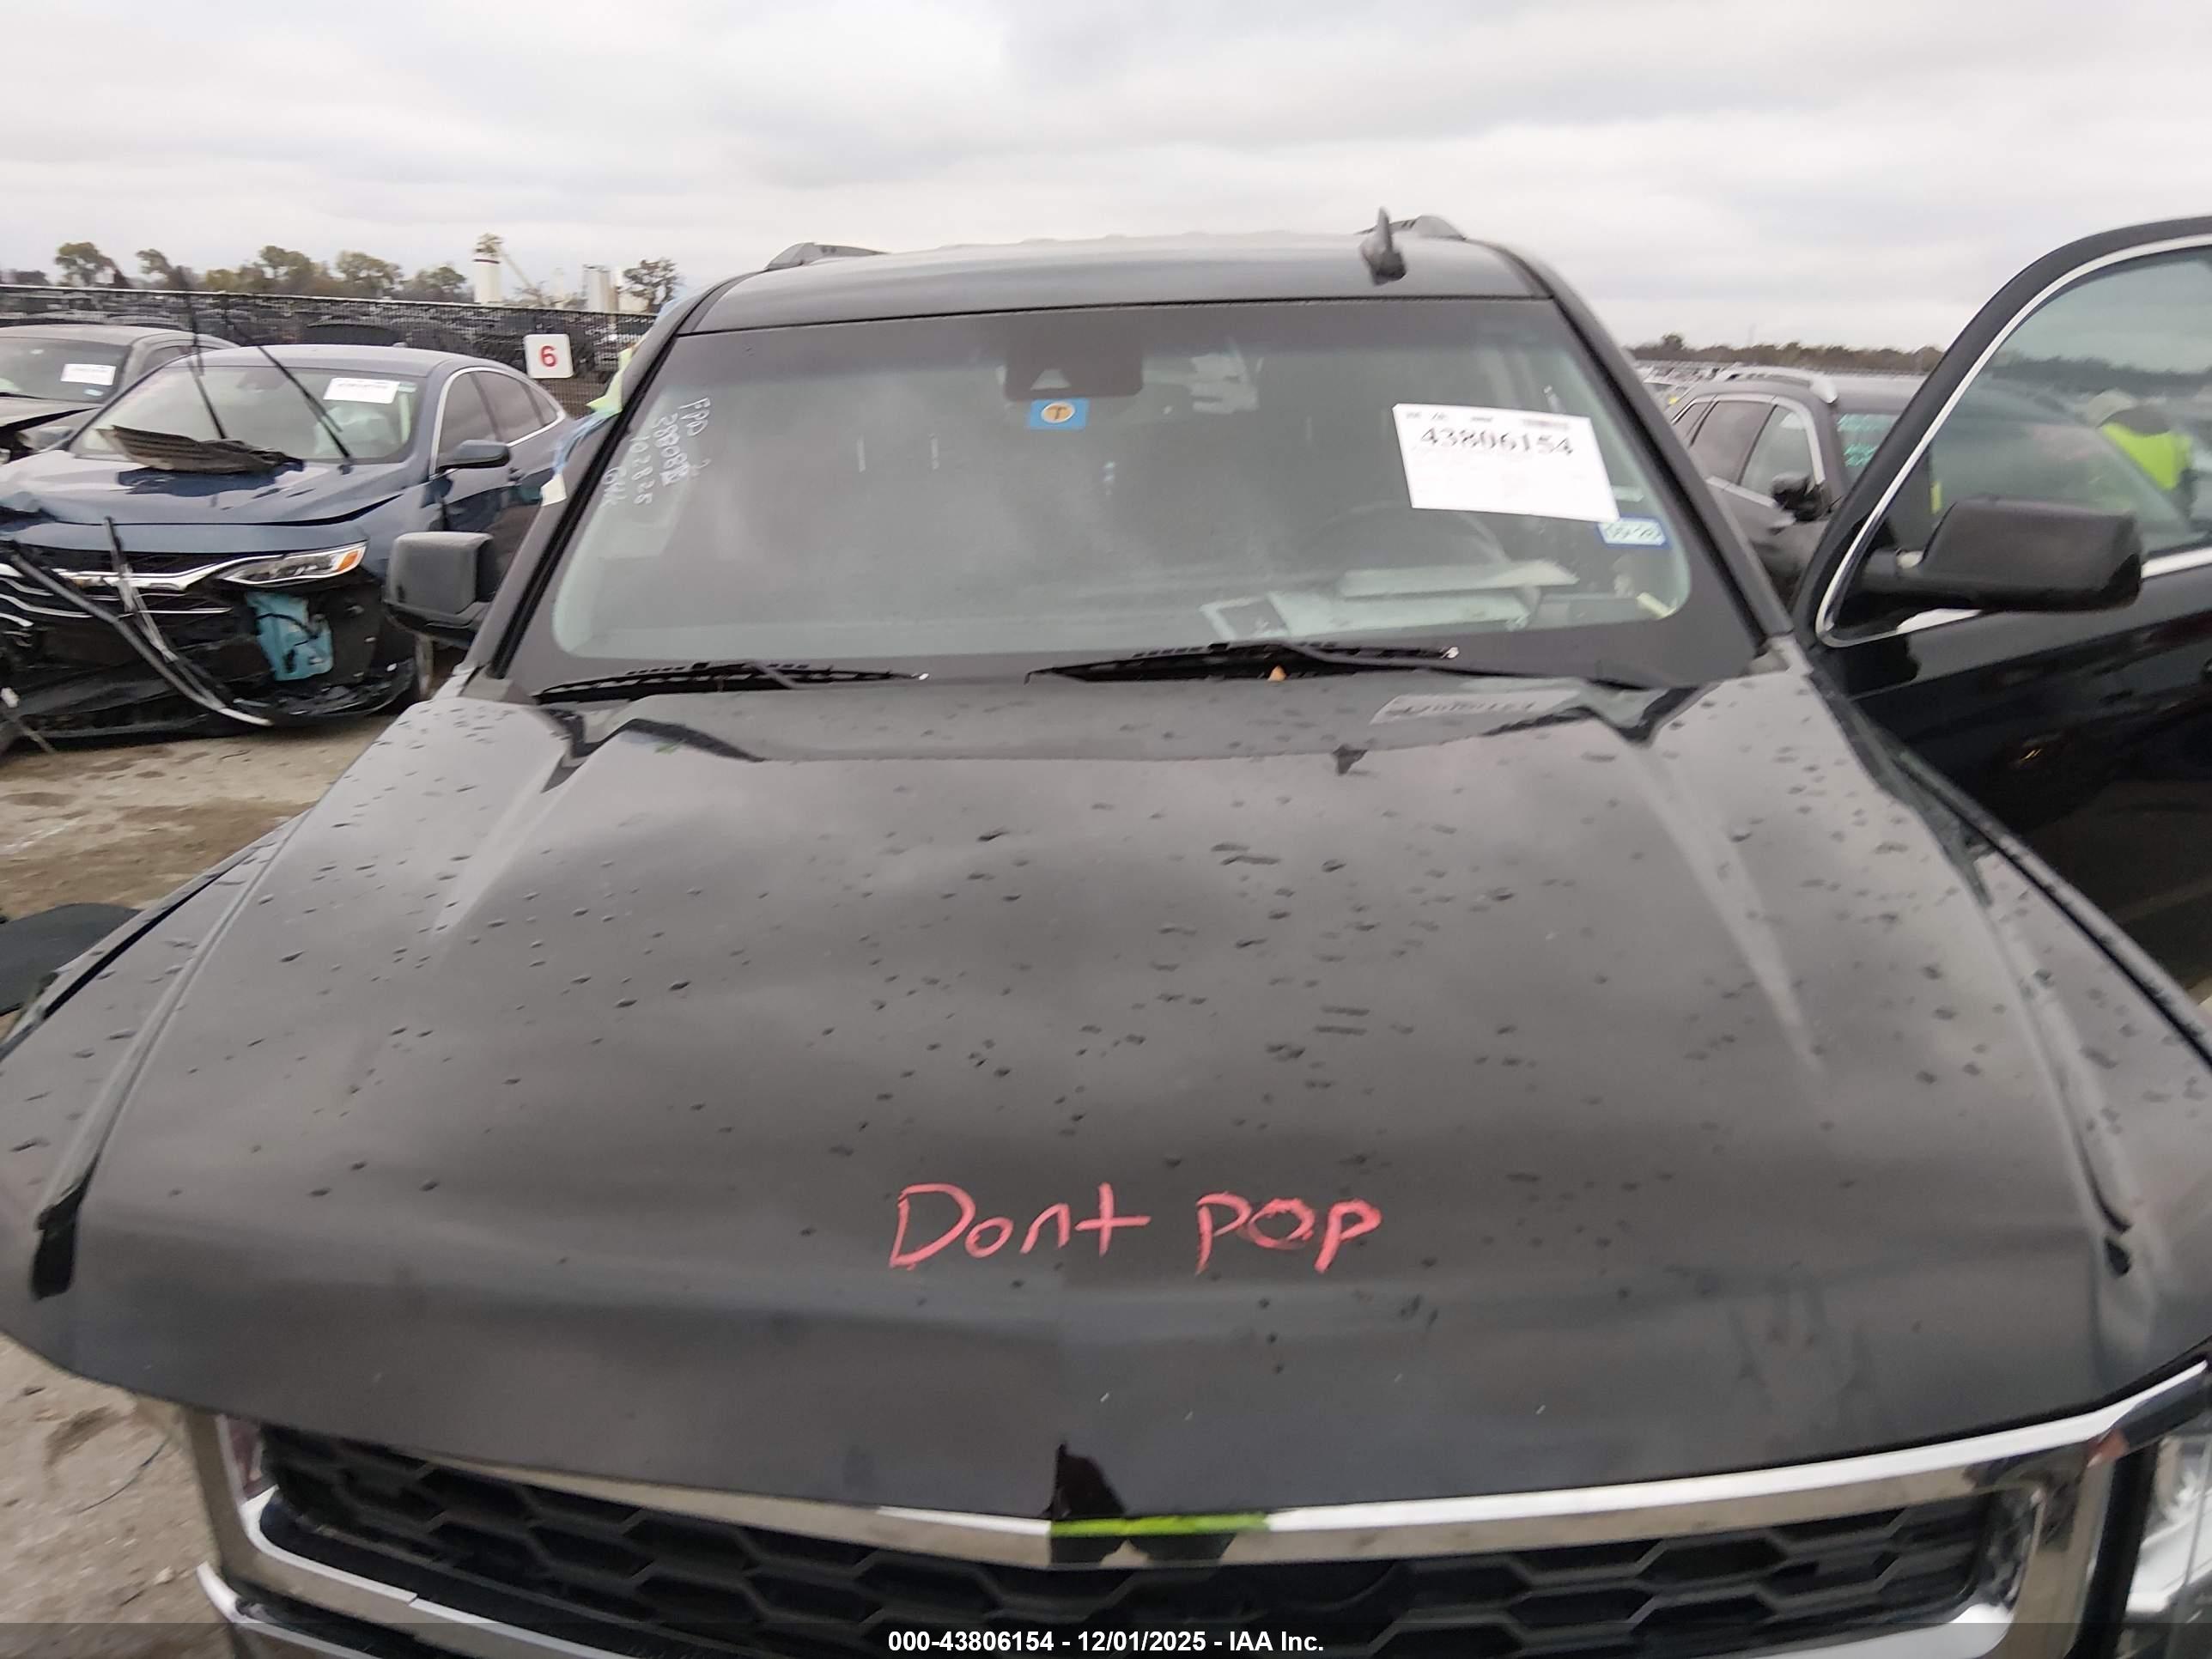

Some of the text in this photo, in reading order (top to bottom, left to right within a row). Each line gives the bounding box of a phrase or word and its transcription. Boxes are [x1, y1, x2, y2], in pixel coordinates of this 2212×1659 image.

[539, 345, 557, 368] 6
[1420, 428, 1573, 456] 43806154
[890, 1182, 1151, 1270] Dont
